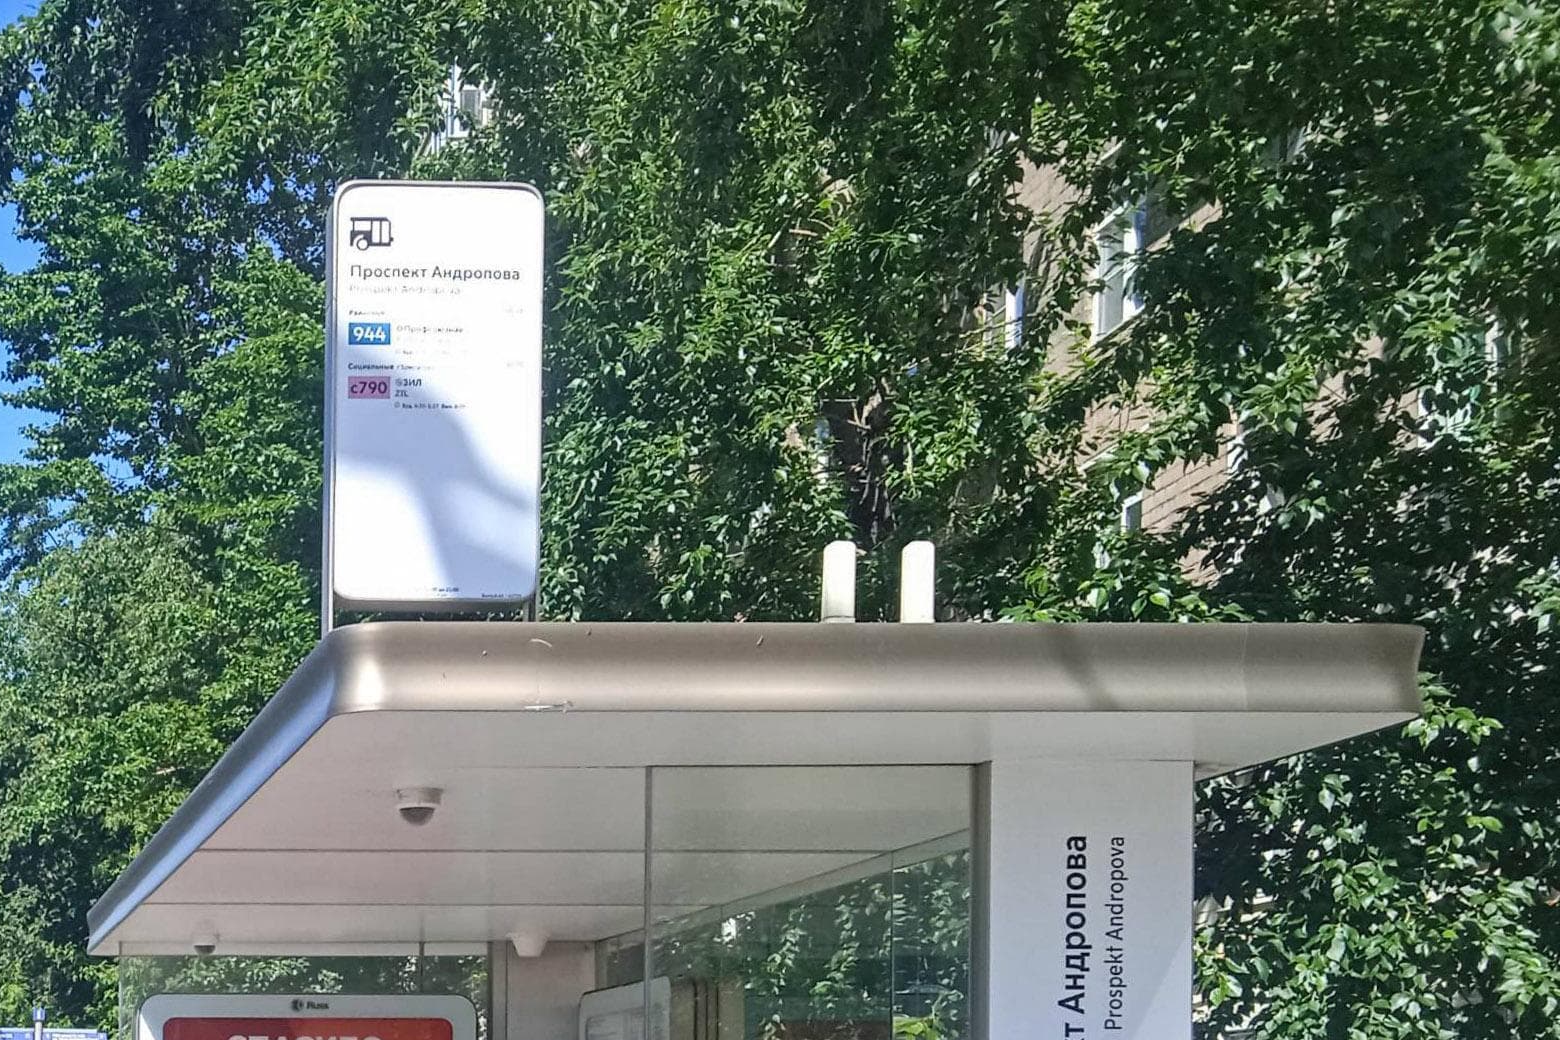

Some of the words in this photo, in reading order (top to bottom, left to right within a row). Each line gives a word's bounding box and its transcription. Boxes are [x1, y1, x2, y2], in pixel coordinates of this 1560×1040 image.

[350, 264, 428, 280] Проспект
[431, 265, 521, 282] Андропова
[353, 326, 387, 342] 944
[1057, 834, 1092, 1015] Андропова
[1105, 836, 1129, 941] Andropova
[1104, 944, 1128, 1031] Prospekt
